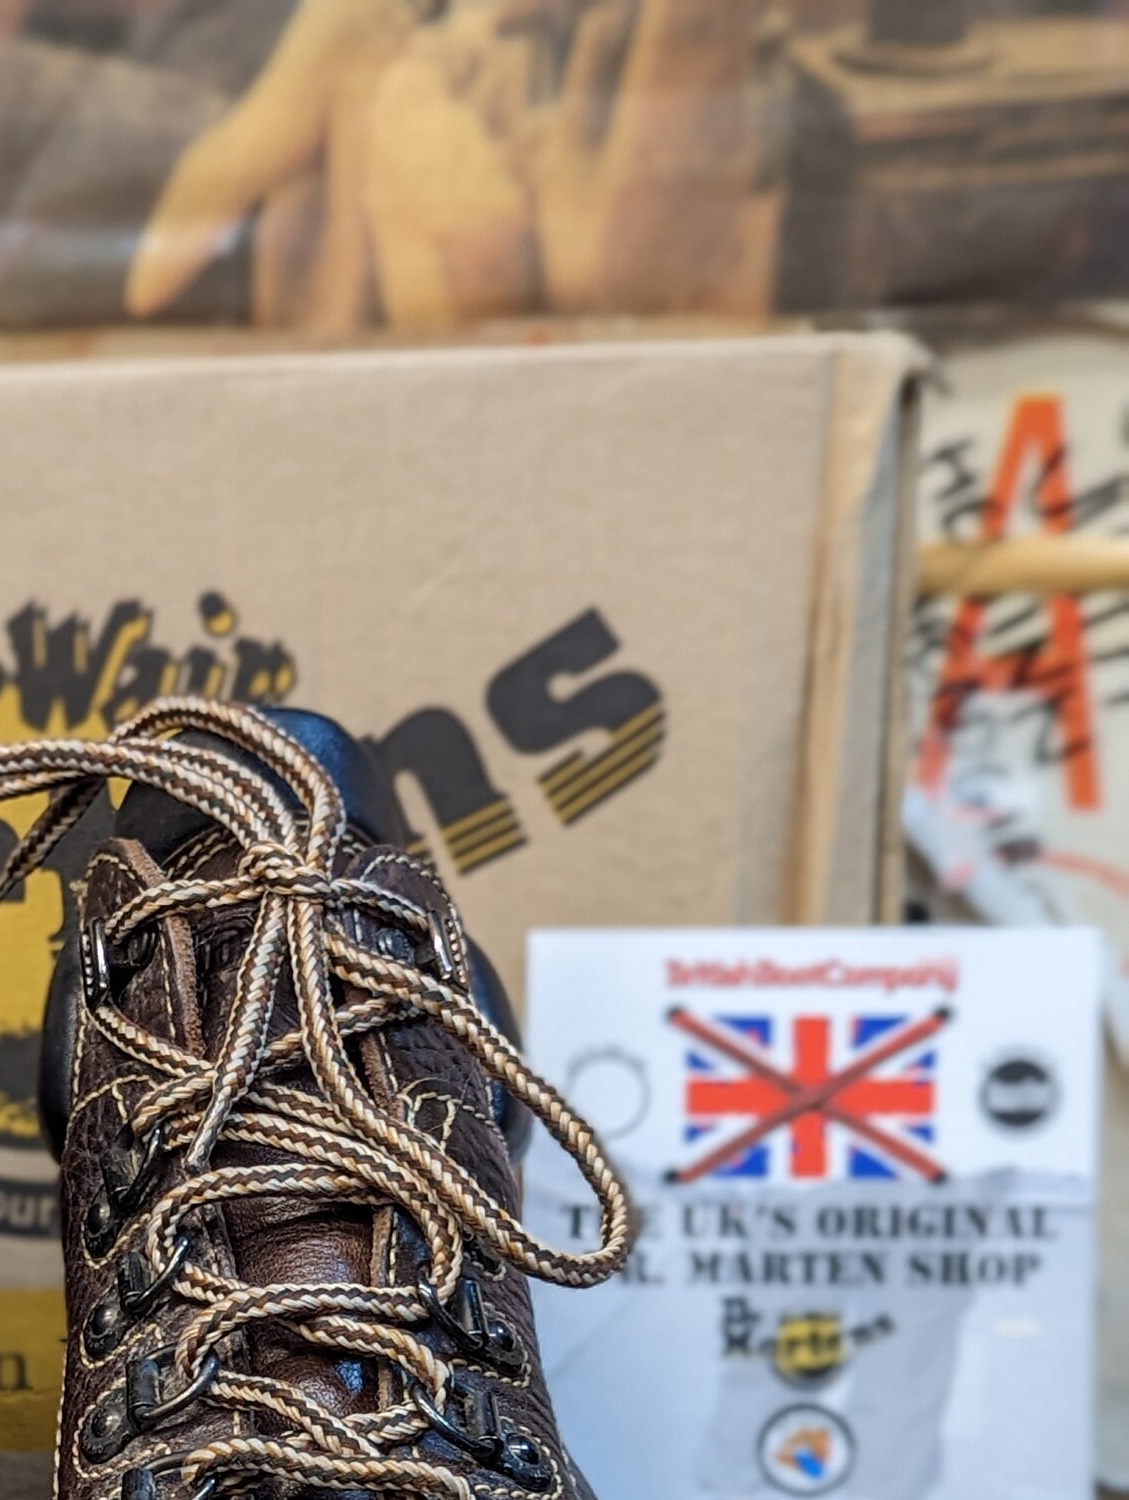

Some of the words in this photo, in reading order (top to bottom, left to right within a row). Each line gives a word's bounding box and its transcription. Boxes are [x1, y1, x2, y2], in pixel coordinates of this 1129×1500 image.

[681, 1204, 799, 1240] UK'S
[816, 1204, 1058, 1241] ORIGINAL
[689, 1251, 888, 1287] MARTEN
[904, 1251, 1043, 1287] SHOP
